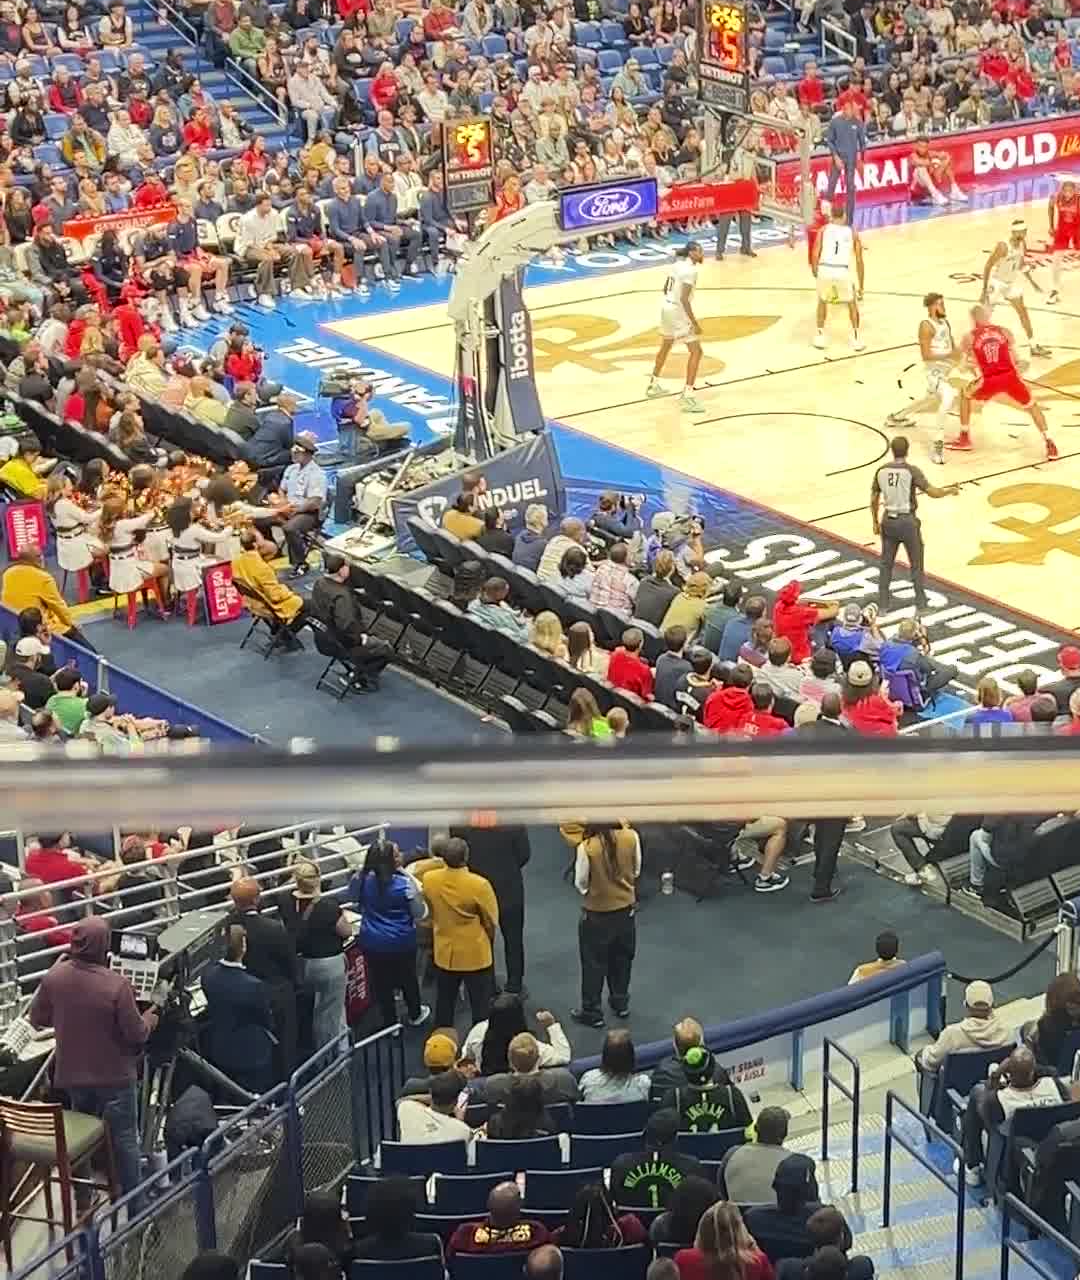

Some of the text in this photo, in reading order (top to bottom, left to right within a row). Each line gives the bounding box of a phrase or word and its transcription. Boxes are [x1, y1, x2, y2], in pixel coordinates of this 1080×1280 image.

[972, 132, 1058, 174] BOLD
[590, 193, 630, 217] Ford
[509, 310, 530, 379] ibotta
[478, 477, 548, 511] NDUEL
[624, 1161, 684, 1189] WILLIAMSO
[648, 1184, 659, 1208] 1
